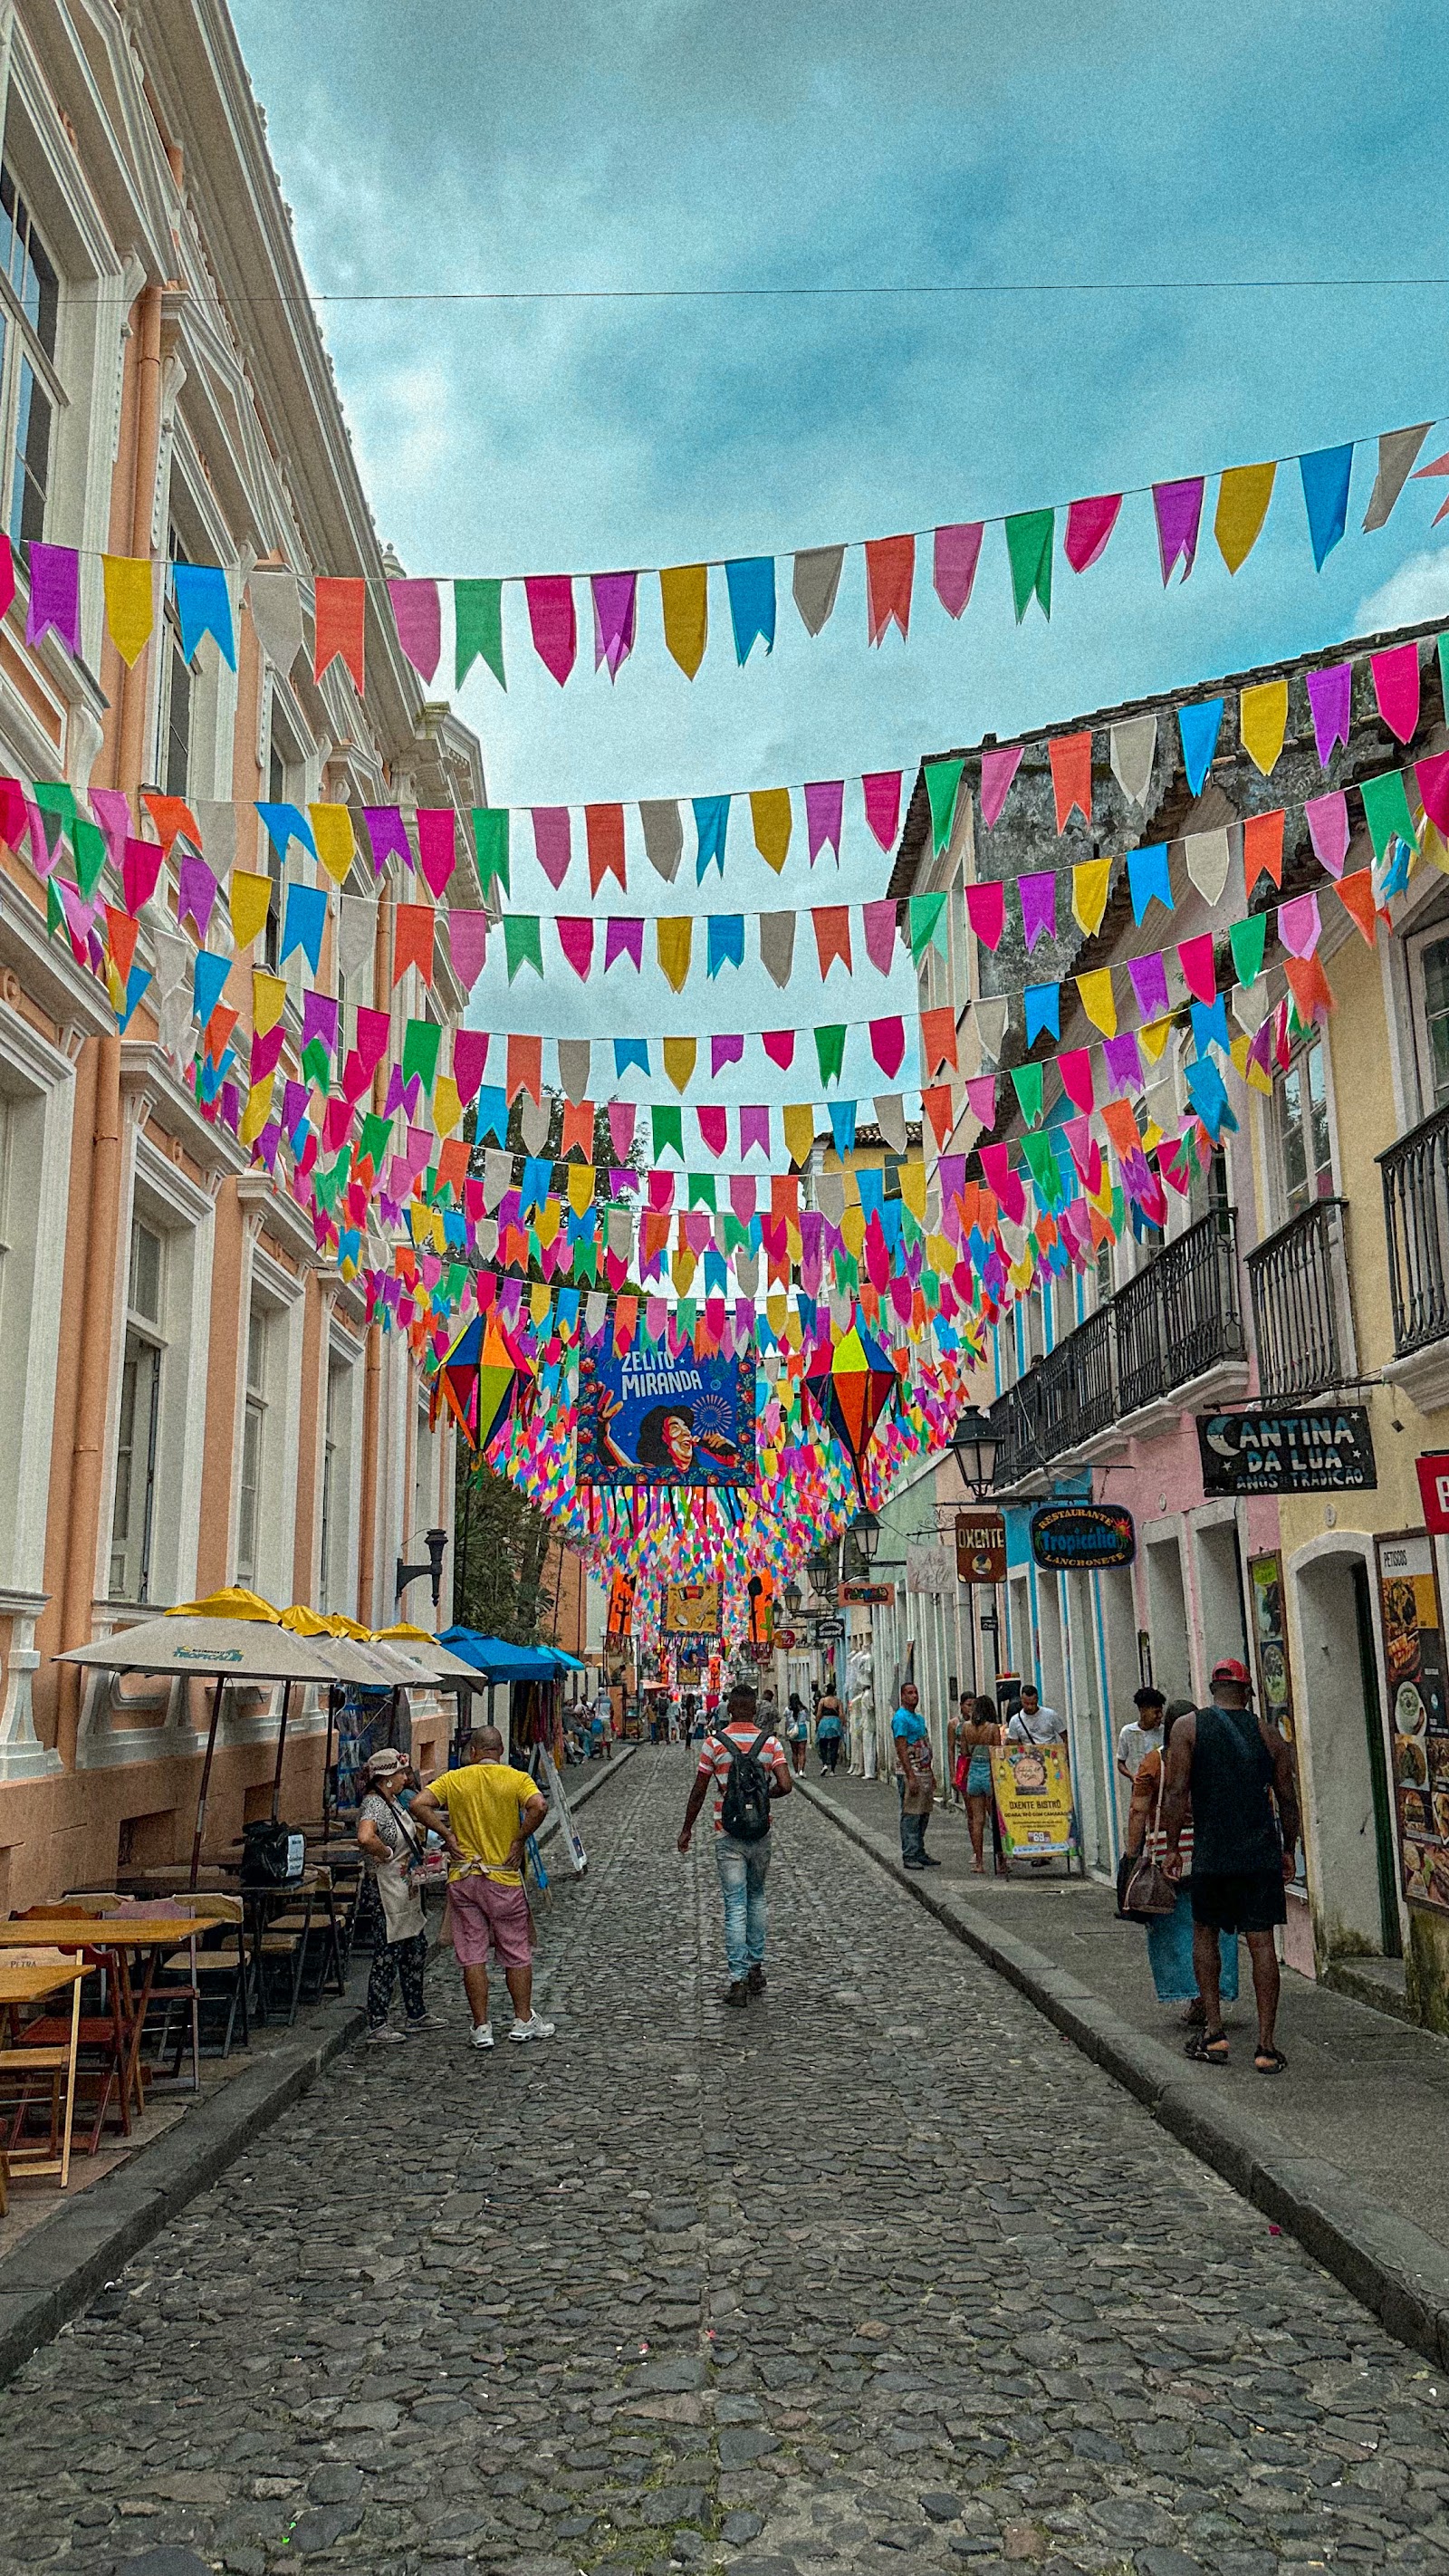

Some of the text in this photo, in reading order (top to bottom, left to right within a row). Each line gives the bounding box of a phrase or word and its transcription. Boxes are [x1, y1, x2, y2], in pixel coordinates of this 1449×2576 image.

[621, 1350, 676, 1372] ZELITO
[621, 1370, 704, 1400] MIRANDA
[1246, 1447, 1343, 1473] DA LUA
[1038, 1508, 1113, 1530] RESTAURANTE
[958, 1528, 1004, 1549] OXENTE
[1041, 1525, 1117, 1555] Tropicália
[1044, 1552, 1126, 1567] LANCHONETE
[1383, 1549, 1407, 1568] PETISCOS
[1009, 1799, 1061, 1810] OXENTE BISTRÔ
[10, 1960, 37, 1968] PETRA
